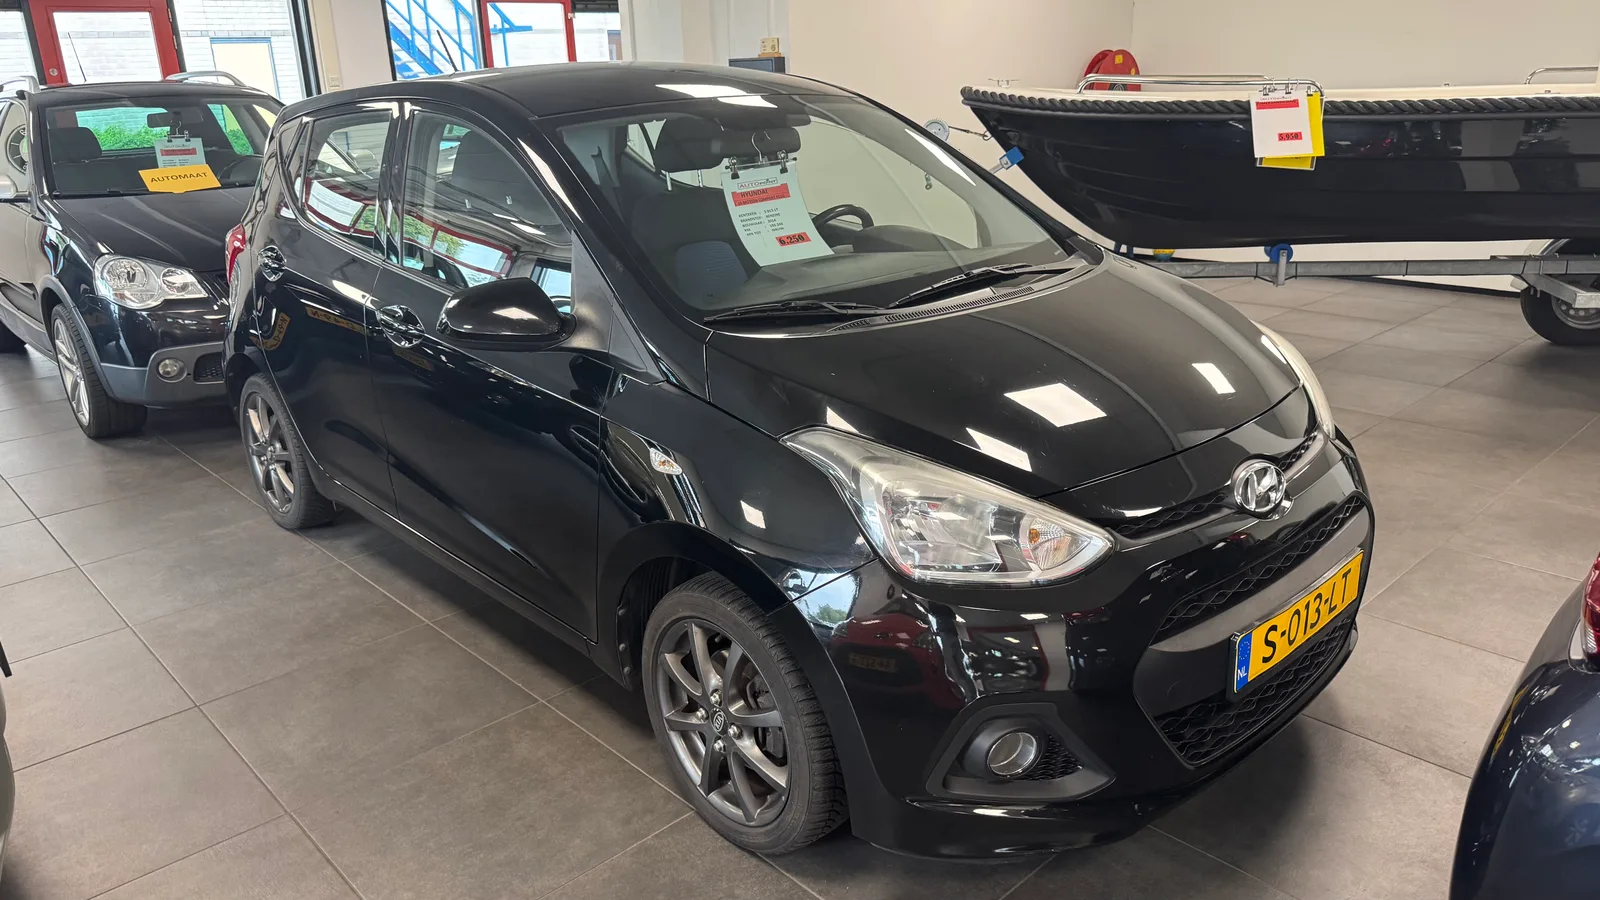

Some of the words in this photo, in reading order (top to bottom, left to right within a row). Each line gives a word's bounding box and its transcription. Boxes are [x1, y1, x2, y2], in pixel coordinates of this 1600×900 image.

[151, 172, 207, 183] AUTOMAAT
[741, 189, 768, 199] HYUNDAI
[779, 234, 805, 245] 6.250
[1237, 665, 1247, 680] NL
[1262, 568, 1351, 663] S-013-LT
